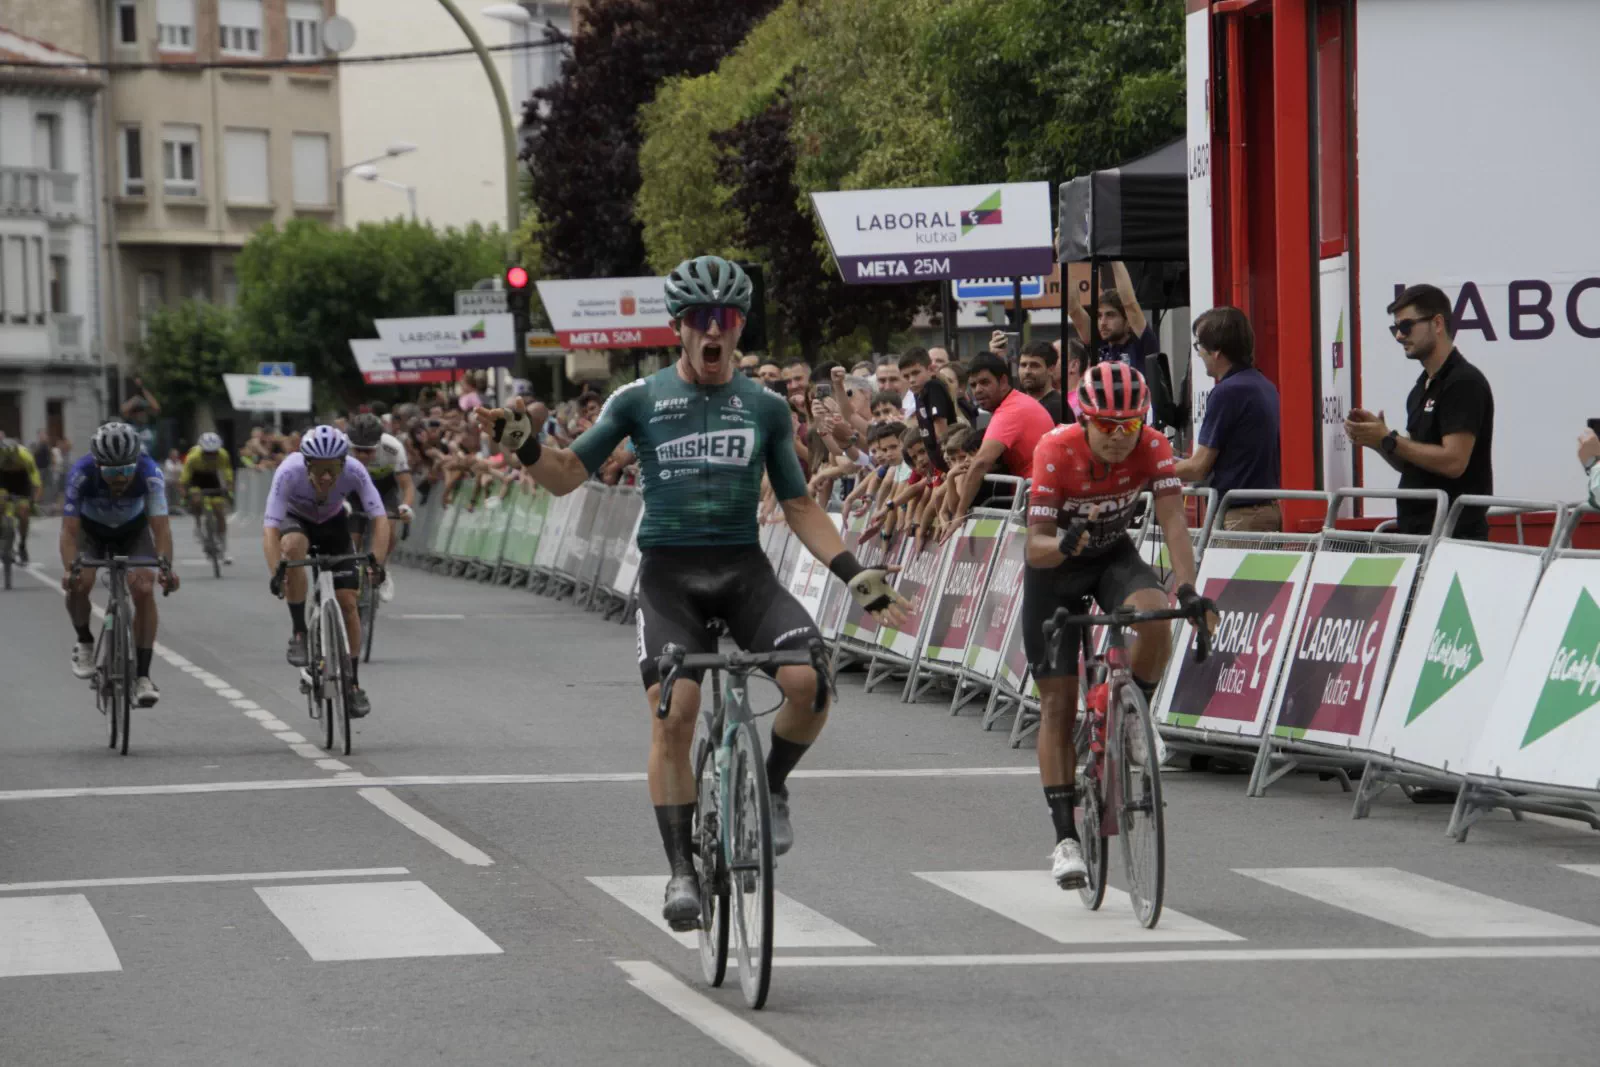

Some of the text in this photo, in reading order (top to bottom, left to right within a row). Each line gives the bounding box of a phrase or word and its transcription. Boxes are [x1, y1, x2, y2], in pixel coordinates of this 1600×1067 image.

[856, 211, 956, 231] LABORAL
[916, 231, 957, 244] kutxa
[857, 258, 950, 277] META 25M
[1394, 277, 1600, 342] ABO
[399, 331, 458, 343] LABORAL
[569, 333, 609, 346] META
[612, 331, 642, 344] 50M
[400, 358, 432, 369] META
[659, 435, 747, 459] FINISHER
[1030, 505, 1059, 519] FROIZ
[1299, 616, 1364, 664] LABORAL
[1216, 662, 1246, 694] kutxa
[1321, 672, 1351, 706] kutxa
